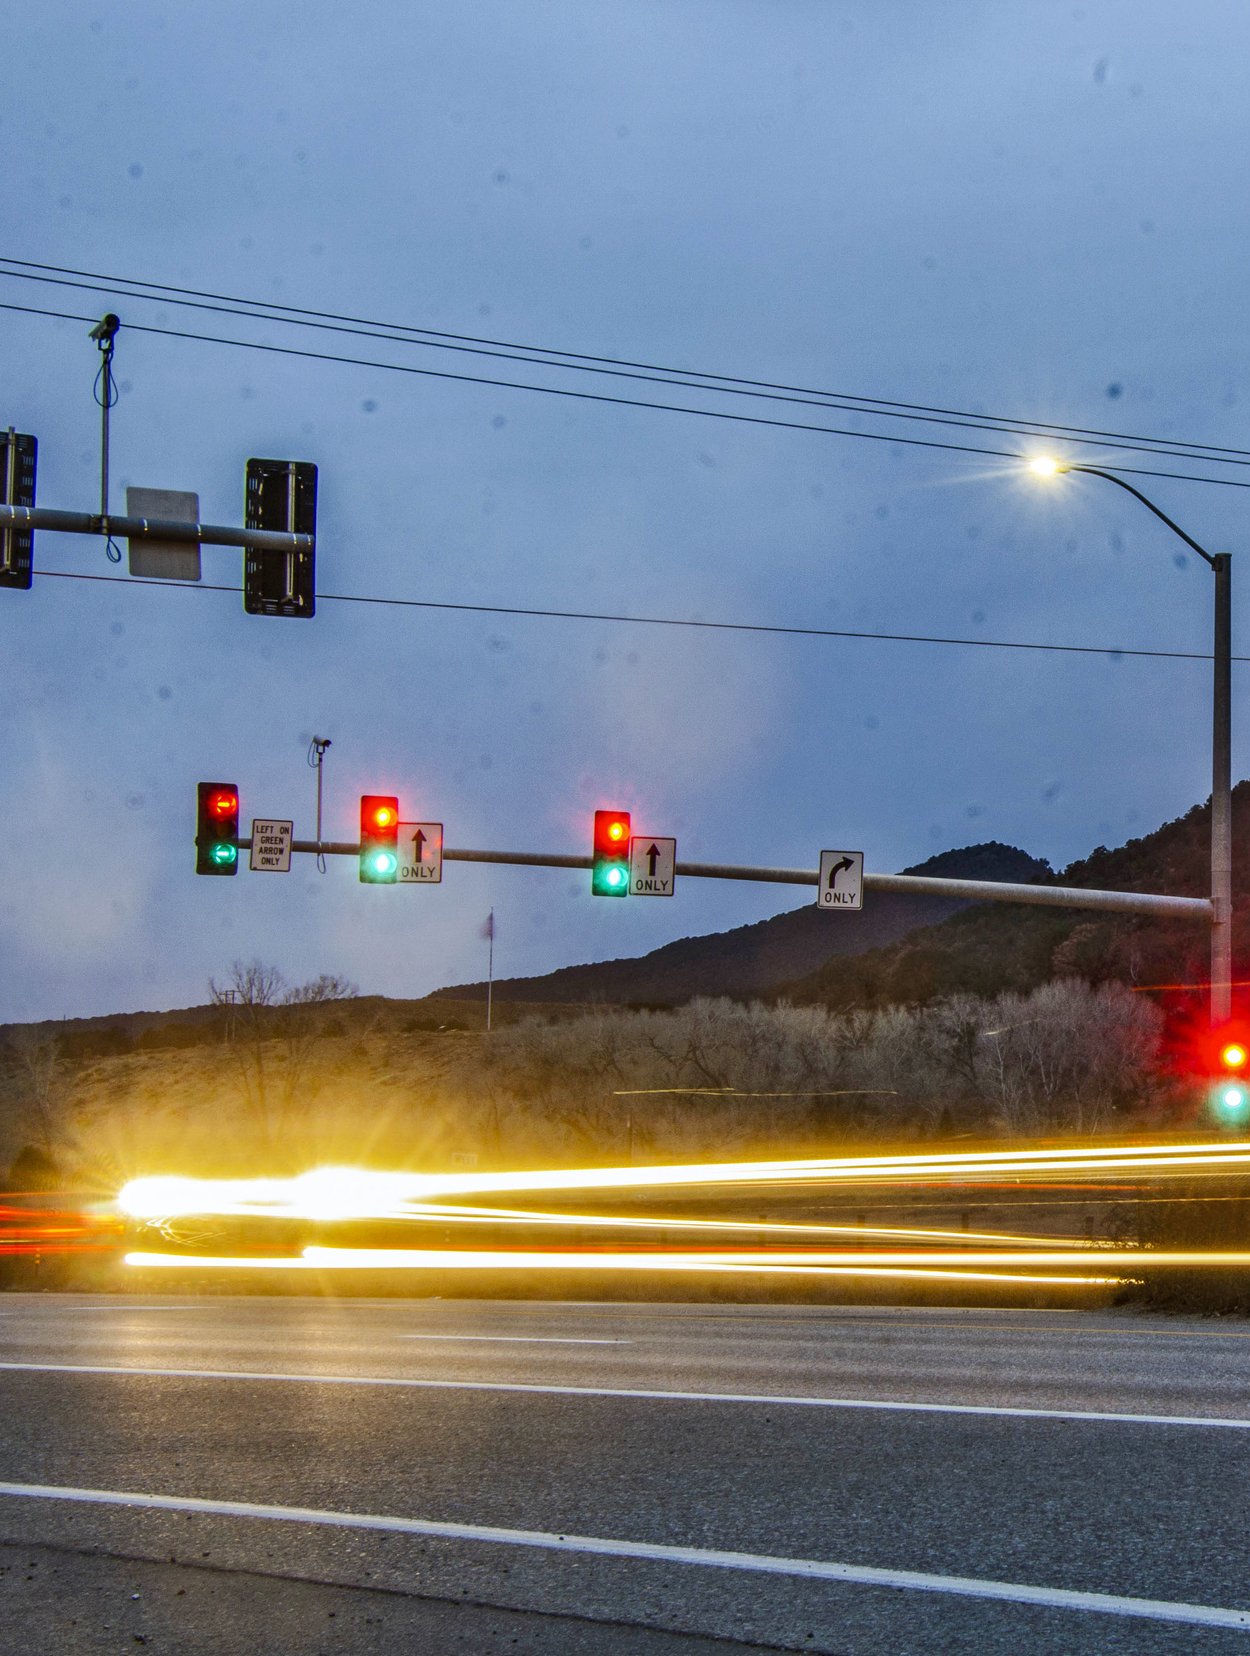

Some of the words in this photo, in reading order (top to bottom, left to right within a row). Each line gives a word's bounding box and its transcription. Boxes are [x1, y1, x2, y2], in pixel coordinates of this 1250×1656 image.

[256, 825, 274, 834] LEFT
[280, 826, 290, 835] ON
[260, 836, 284, 845] GREEN
[258, 846, 285, 856] ARROW
[261, 857, 280, 866] ONLY
[402, 866, 436, 878] ONLY
[636, 879, 669, 891] ONLY
[824, 892, 856, 904] ONLY
